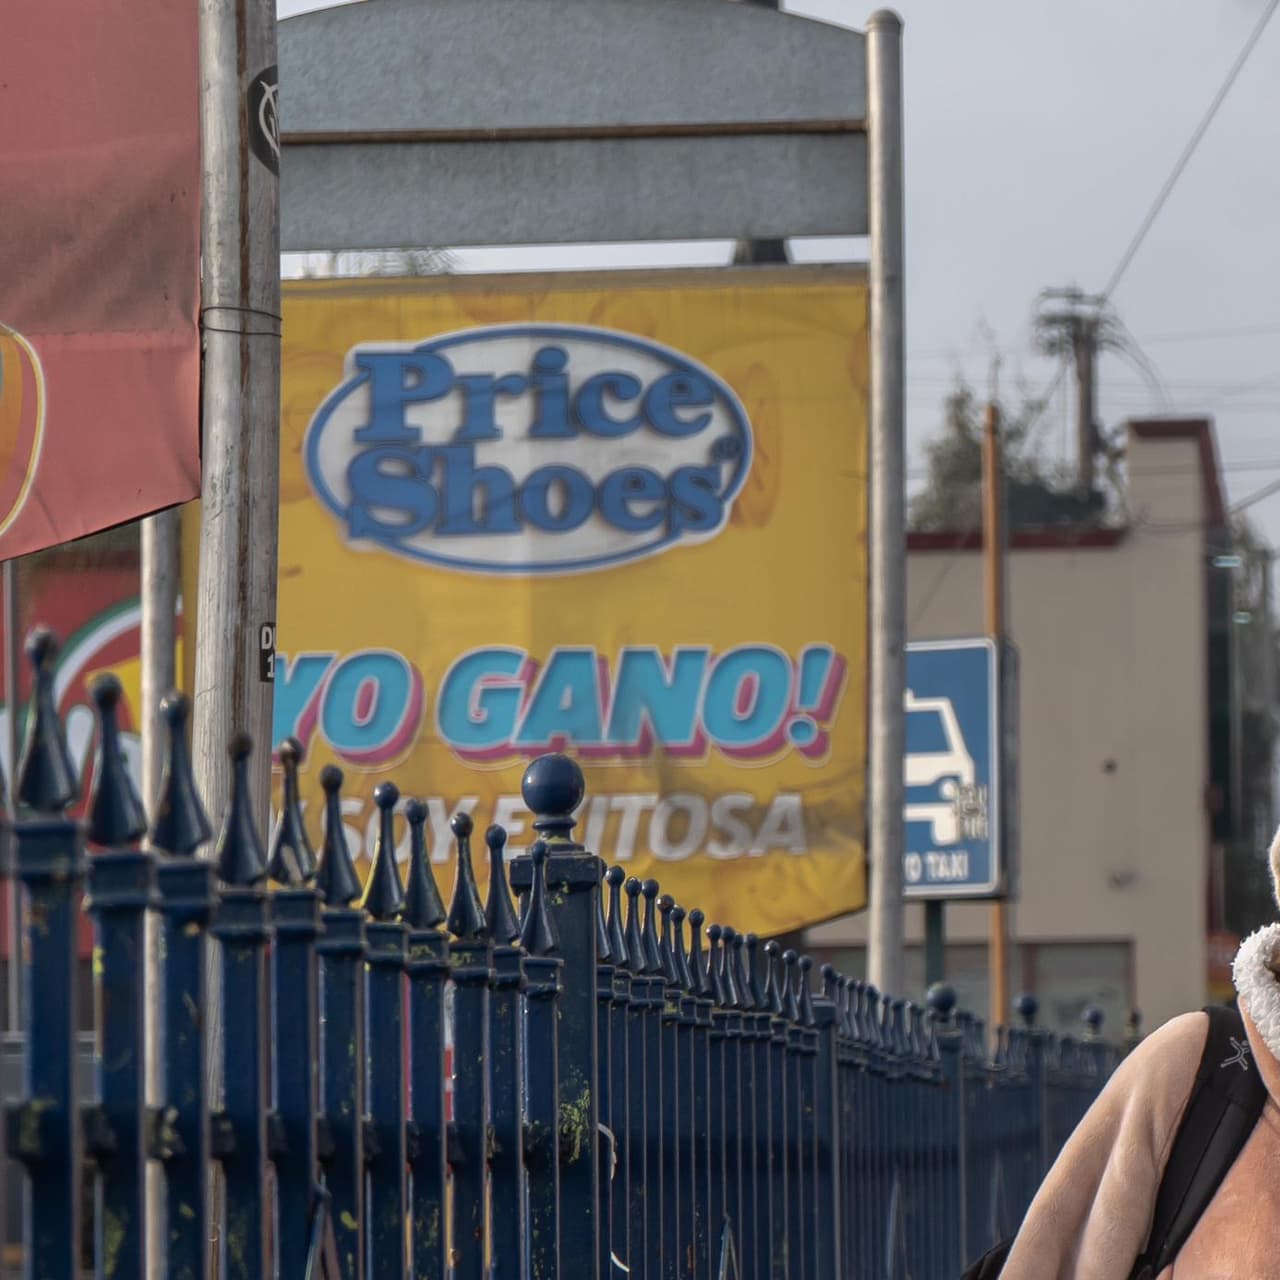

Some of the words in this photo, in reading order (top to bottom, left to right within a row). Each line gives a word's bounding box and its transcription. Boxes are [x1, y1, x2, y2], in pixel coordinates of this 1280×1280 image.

[353, 346, 718, 443] Price
[347, 444, 727, 540] Shoes
[272, 648, 424, 768] YO
[436, 643, 846, 768] GANO!
[487, 793, 808, 863] EITOSA
[925, 851, 968, 880] TAXI
